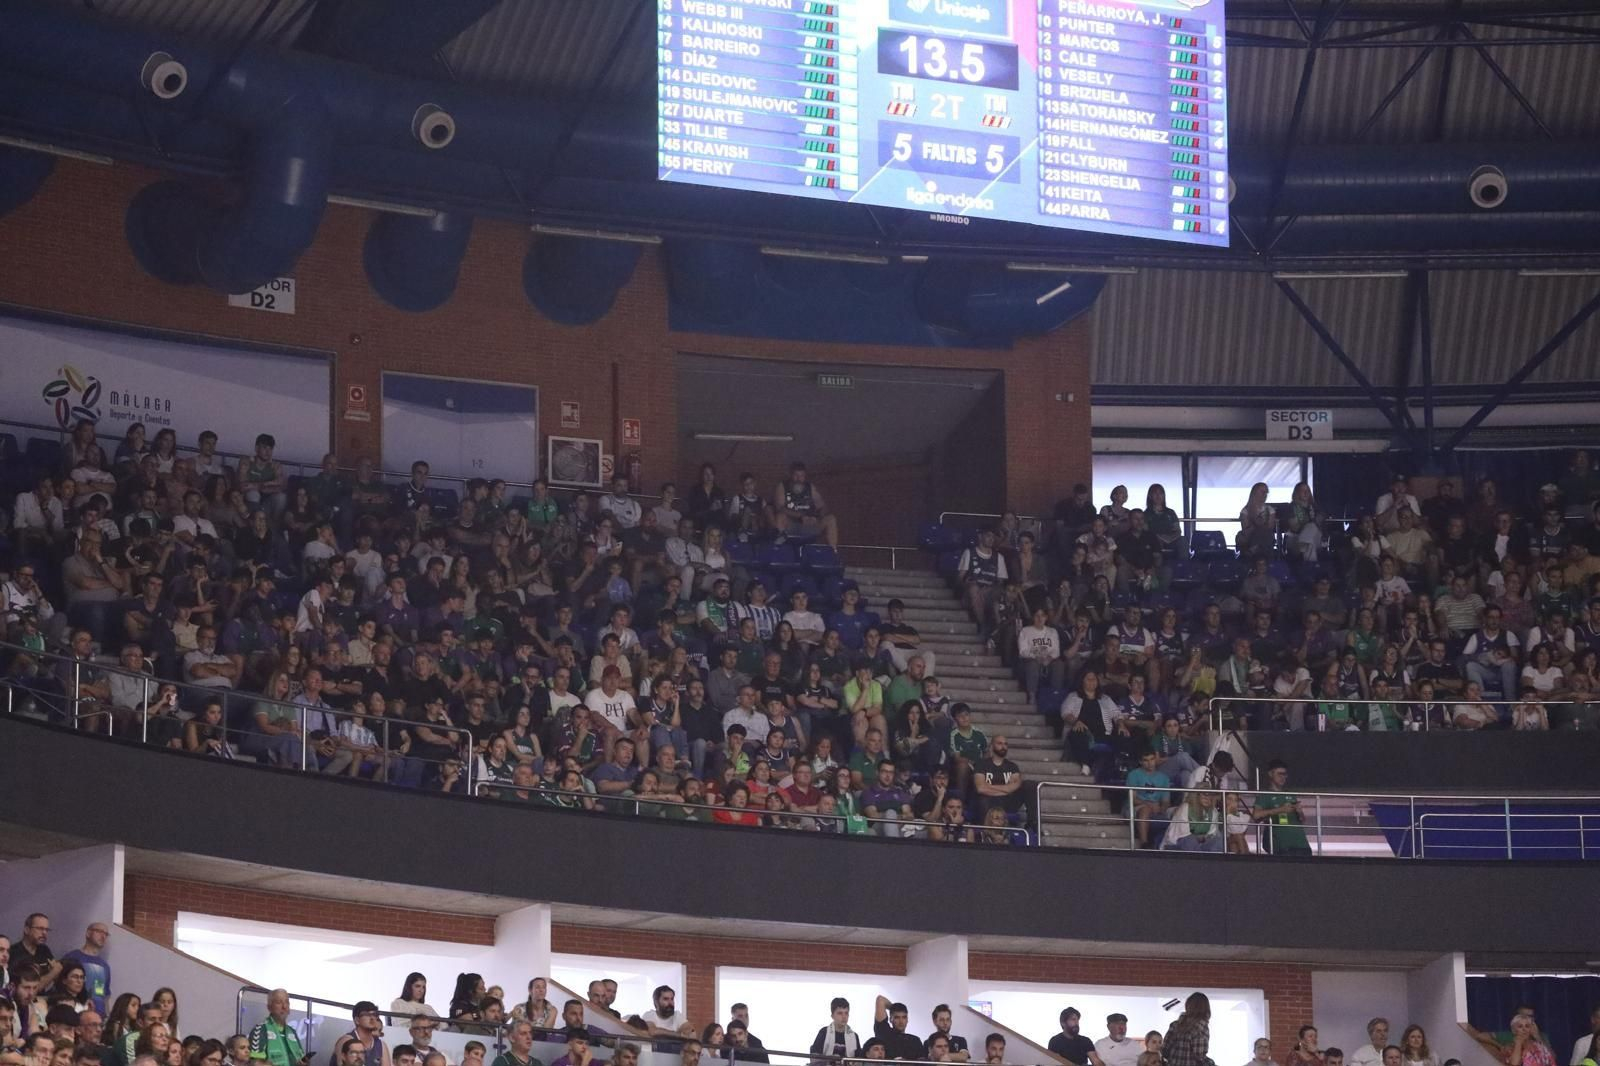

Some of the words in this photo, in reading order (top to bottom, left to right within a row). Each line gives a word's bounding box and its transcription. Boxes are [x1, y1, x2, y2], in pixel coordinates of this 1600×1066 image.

[682, 1, 727, 19] WEBB
[1152, 13, 1164, 26] J.
[664, 15, 672, 28] 4
[682, 17, 763, 39] KALINOSKI
[1059, 16, 1116, 35] PUNTER
[664, 32, 672, 45] 7
[682, 35, 760, 57] BARREIRO
[1043, 32, 1052, 44] 2
[1059, 33, 1120, 52] MARCOS
[682, 51, 718, 69] DÍAZ
[900, 34, 986, 83] 13.5
[1043, 49, 1052, 61] 3
[1059, 50, 1097, 68] CALE
[1212, 70, 1222, 83] 2
[664, 68, 680, 82] 14
[682, 71, 758, 91] DJEDOVIC
[1059, 67, 1114, 86] VESELY
[1213, 86, 1222, 99] 2
[664, 85, 681, 99] 19
[682, 88, 799, 113] SULEJMANOVIC
[1060, 84, 1129, 104] BRIZUELA
[664, 104, 679, 117] 27
[682, 106, 744, 125] DUARTE
[930, 93, 964, 120] 2T
[1045, 102, 1061, 115] 13
[1061, 103, 1156, 125] SATORANSKY
[1213, 120, 1223, 133] 2
[664, 120, 681, 134] 33
[683, 123, 729, 140] TILLIE
[1045, 118, 1061, 131] 14
[1061, 119, 1169, 144] HERNANGÓMEZ
[1213, 136, 1223, 149] 4
[664, 138, 681, 152] 45
[683, 140, 749, 159] KRAVISH
[893, 132, 912, 162] 5
[922, 142, 977, 165] FALTAS
[985, 144, 1004, 173] 5
[1046, 134, 1061, 148] 19
[1061, 136, 1096, 151] FALL
[665, 155, 681, 170] 55
[683, 158, 735, 175] PERRY
[1046, 151, 1061, 164] 21
[1061, 153, 1128, 172] CLYBURN
[1046, 168, 1061, 181] 23
[1061, 170, 1141, 191] SHENGELIA
[1046, 186, 1062, 198] 41
[1062, 187, 1103, 203] KEITA
[937, 214, 970, 226] MONDO
[1046, 203, 1062, 216] 44
[1062, 204, 1112, 221] PARRA
[1215, 220, 1225, 234] 4
[251, 291, 276, 310] D2
[821, 376, 851, 386] SALIDA
[110, 390, 171, 413] MÁLAGA
[1271, 410, 1329, 422] SECTOR
[1288, 425, 1313, 440] D3
